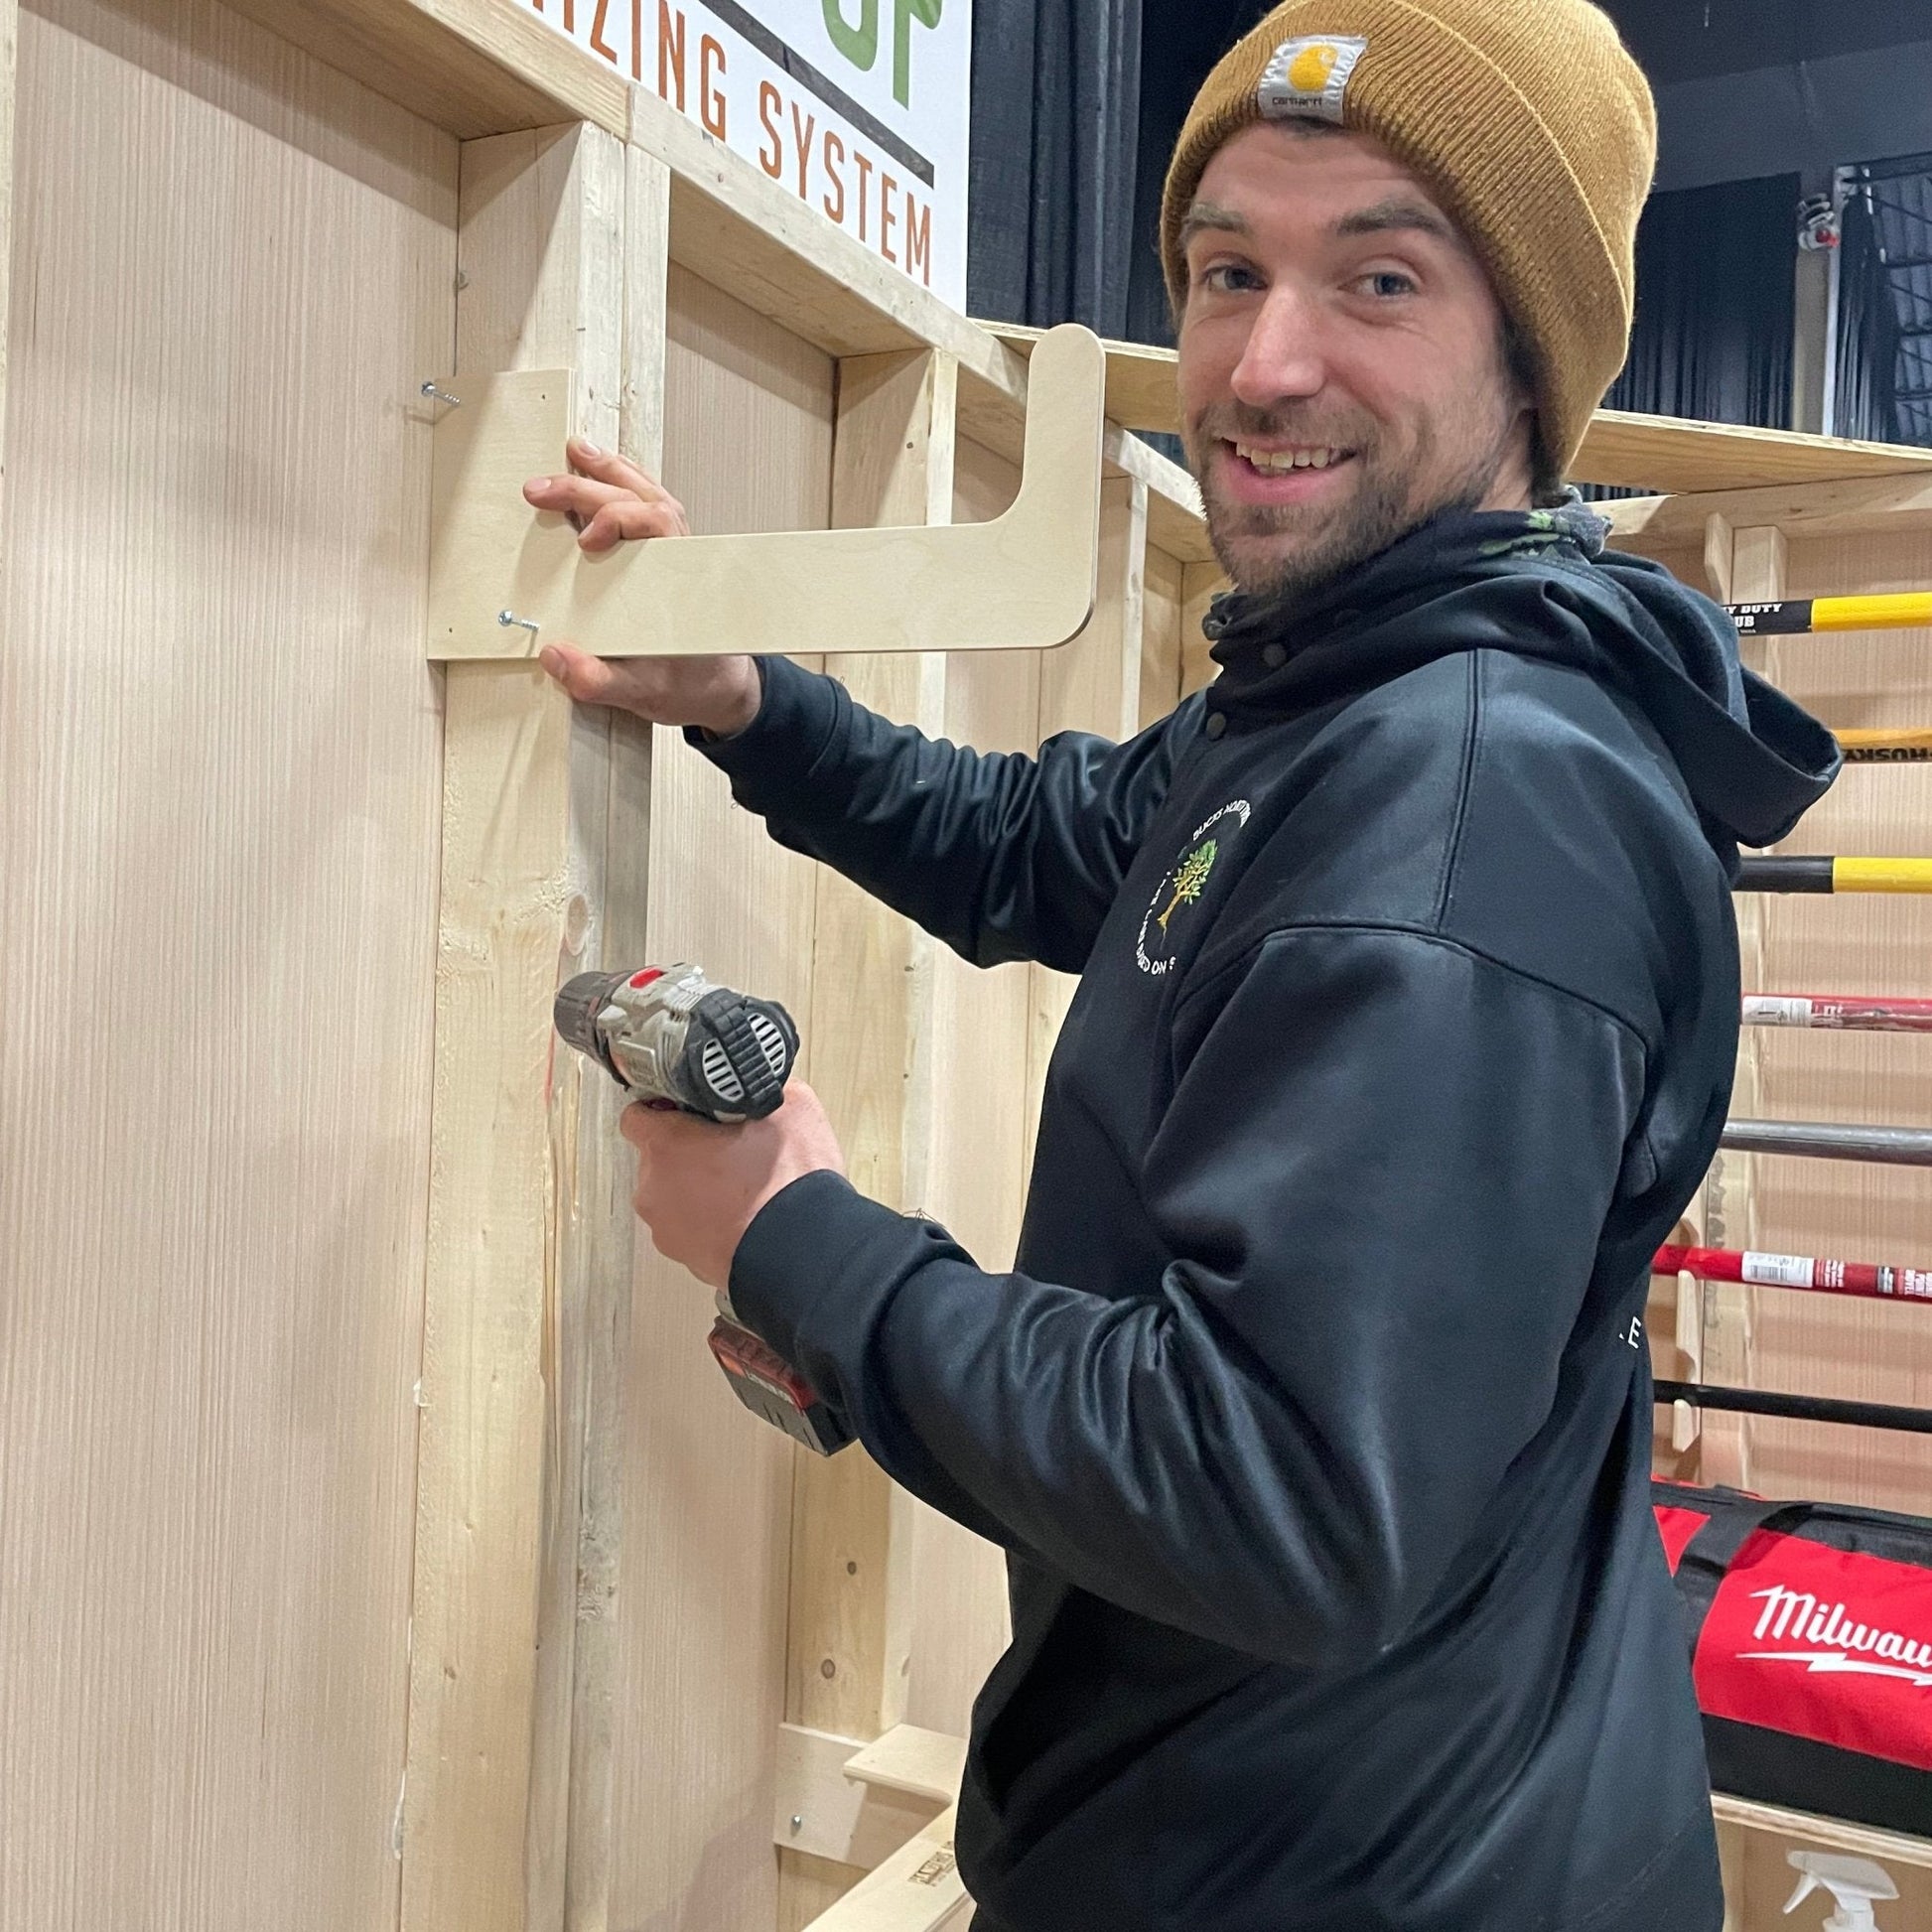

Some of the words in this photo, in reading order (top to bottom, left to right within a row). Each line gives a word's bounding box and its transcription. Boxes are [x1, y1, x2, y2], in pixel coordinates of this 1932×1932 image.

[533, 0, 726, 142] ZING
[759, 80, 931, 287] SYSTEM
[1740, 604, 1782, 614] DUTY
[1845, 748, 1928, 761] HUSKY
[1749, 1585, 1932, 1667] Milwau
